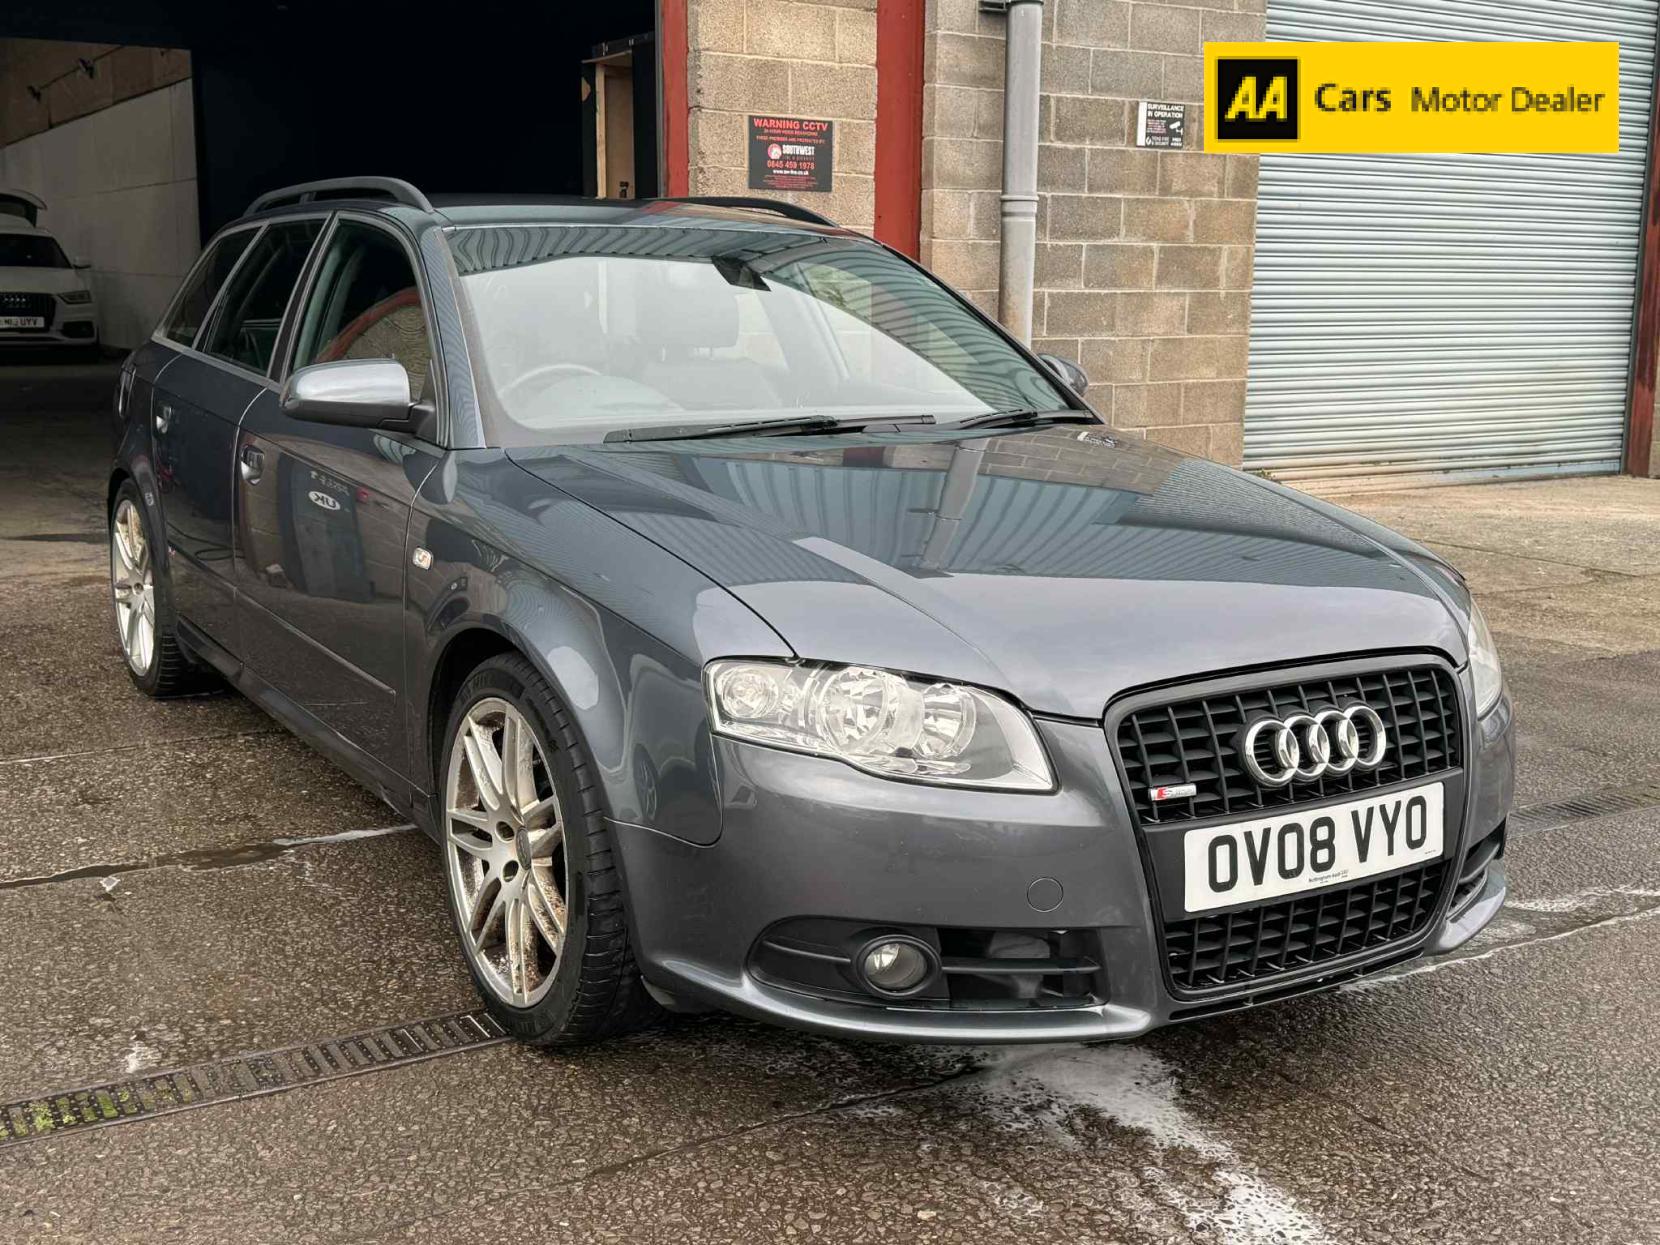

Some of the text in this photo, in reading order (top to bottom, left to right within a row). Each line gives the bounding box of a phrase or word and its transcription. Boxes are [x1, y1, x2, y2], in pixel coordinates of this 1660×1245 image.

[1147, 103, 1184, 111] SURVEILLANCE
[754, 118, 828, 131] WARNING CCTV
[782, 144, 815, 156] SOUTHWEST
[1208, 795, 1427, 893] OV08 VYO
